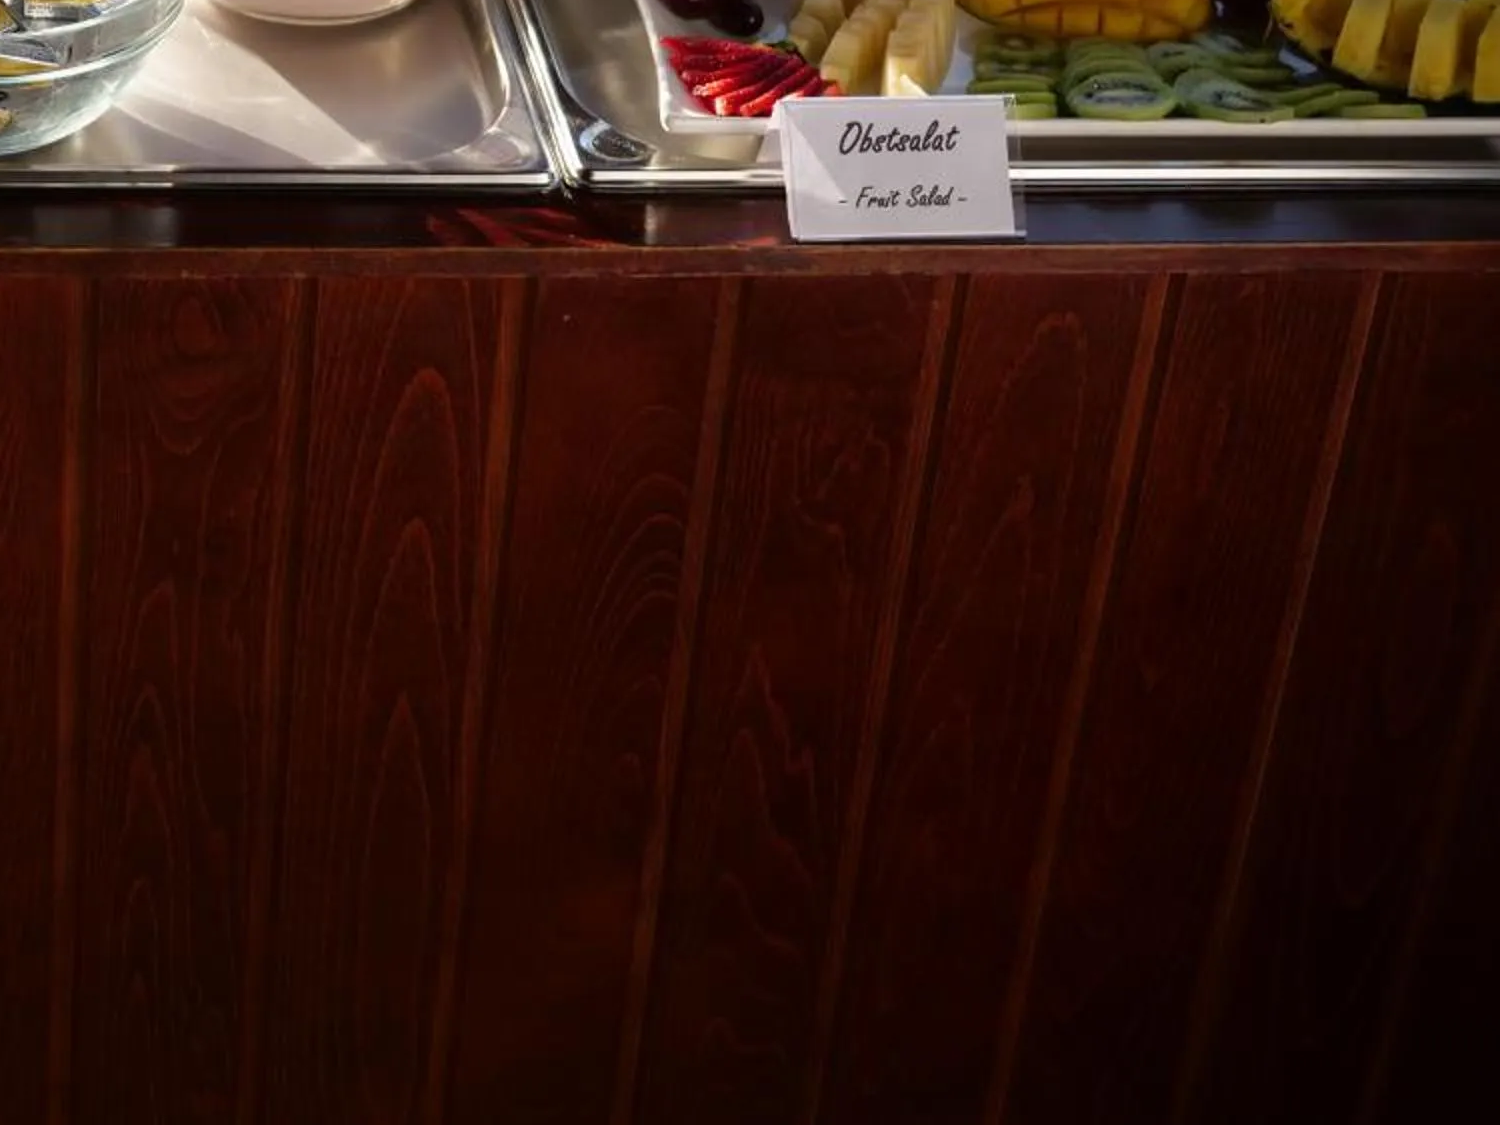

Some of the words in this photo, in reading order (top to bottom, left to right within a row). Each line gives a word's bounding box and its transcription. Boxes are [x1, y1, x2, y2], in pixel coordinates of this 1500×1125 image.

[838, 120, 960, 154] Obstsalat
[855, 186, 900, 209] Fruit
[906, 184, 955, 208] Salad
